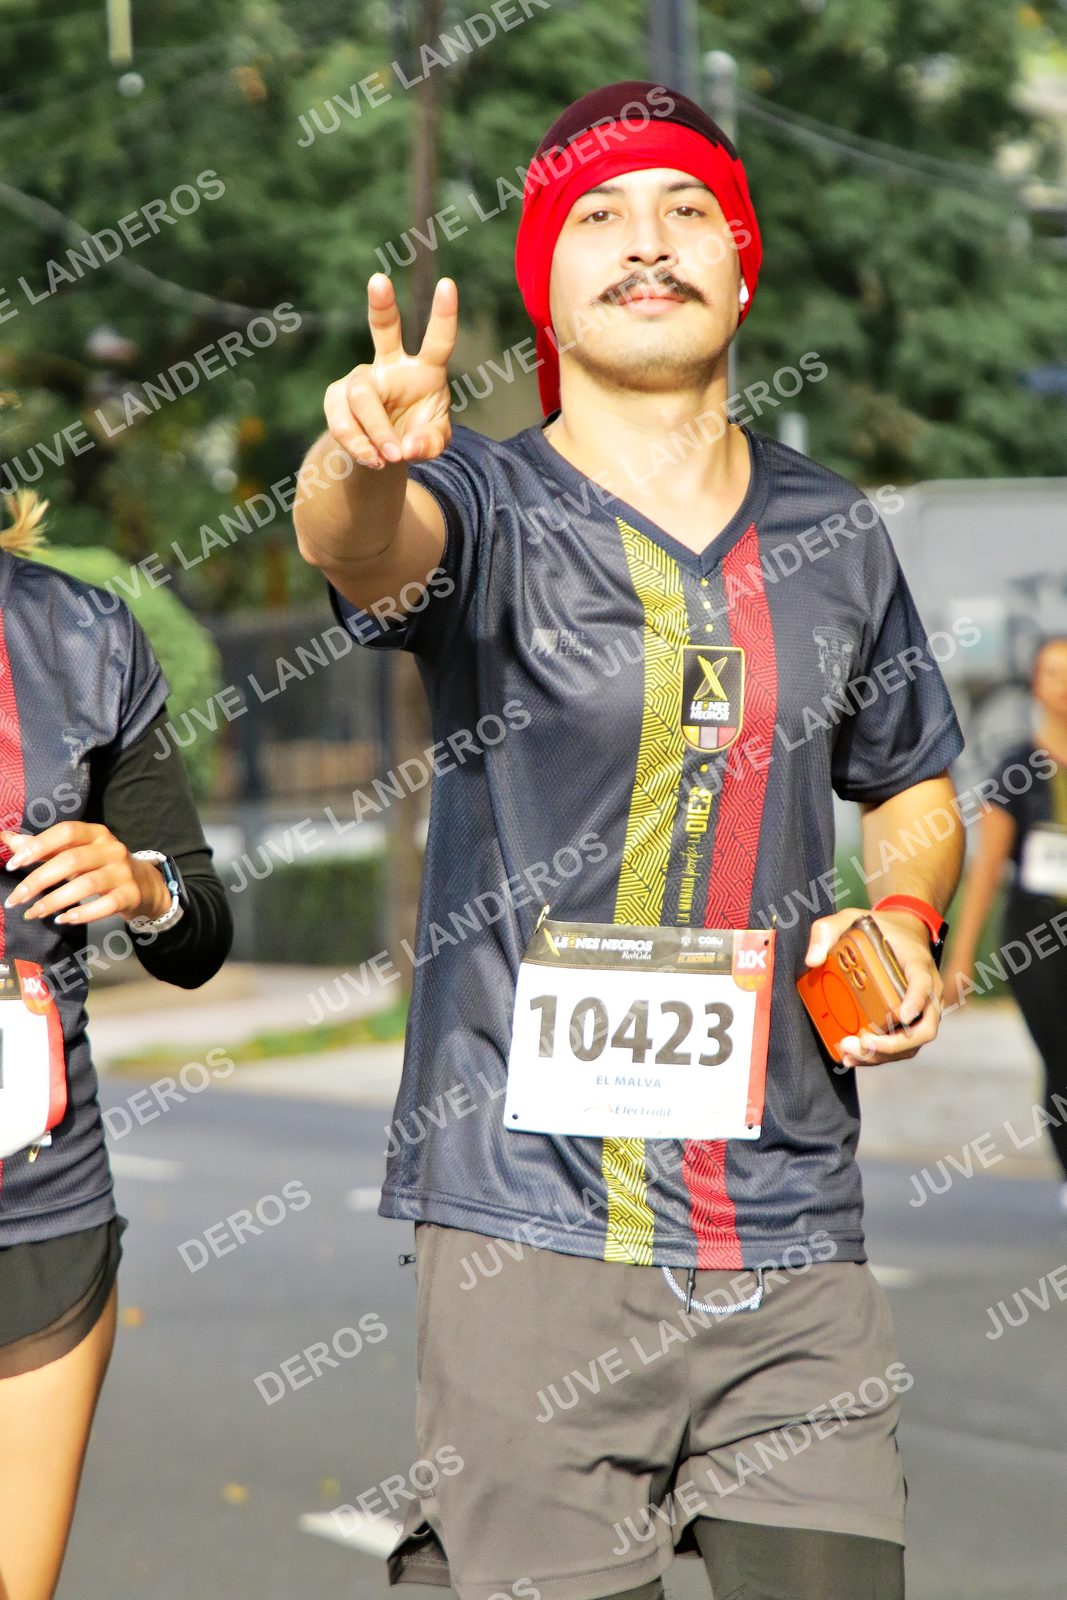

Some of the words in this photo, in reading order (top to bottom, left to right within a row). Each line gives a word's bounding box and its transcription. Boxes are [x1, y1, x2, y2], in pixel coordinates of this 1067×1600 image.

[690, 701, 730, 711] LEONES
[690, 711, 730, 720] NEGROS
[685, 790, 712, 833] DIEZ
[690, 833, 702, 843] LA
[678, 877, 695, 911] MANADA
[677, 913, 690, 923] LA
[554, 936, 600, 950] LEONES
[601, 938, 653, 952] NEGROS
[737, 950, 767, 969] 10K
[530, 994, 734, 1067] 10423
[596, 1075, 612, 1086] EL
[614, 1076, 662, 1089] MALVA
